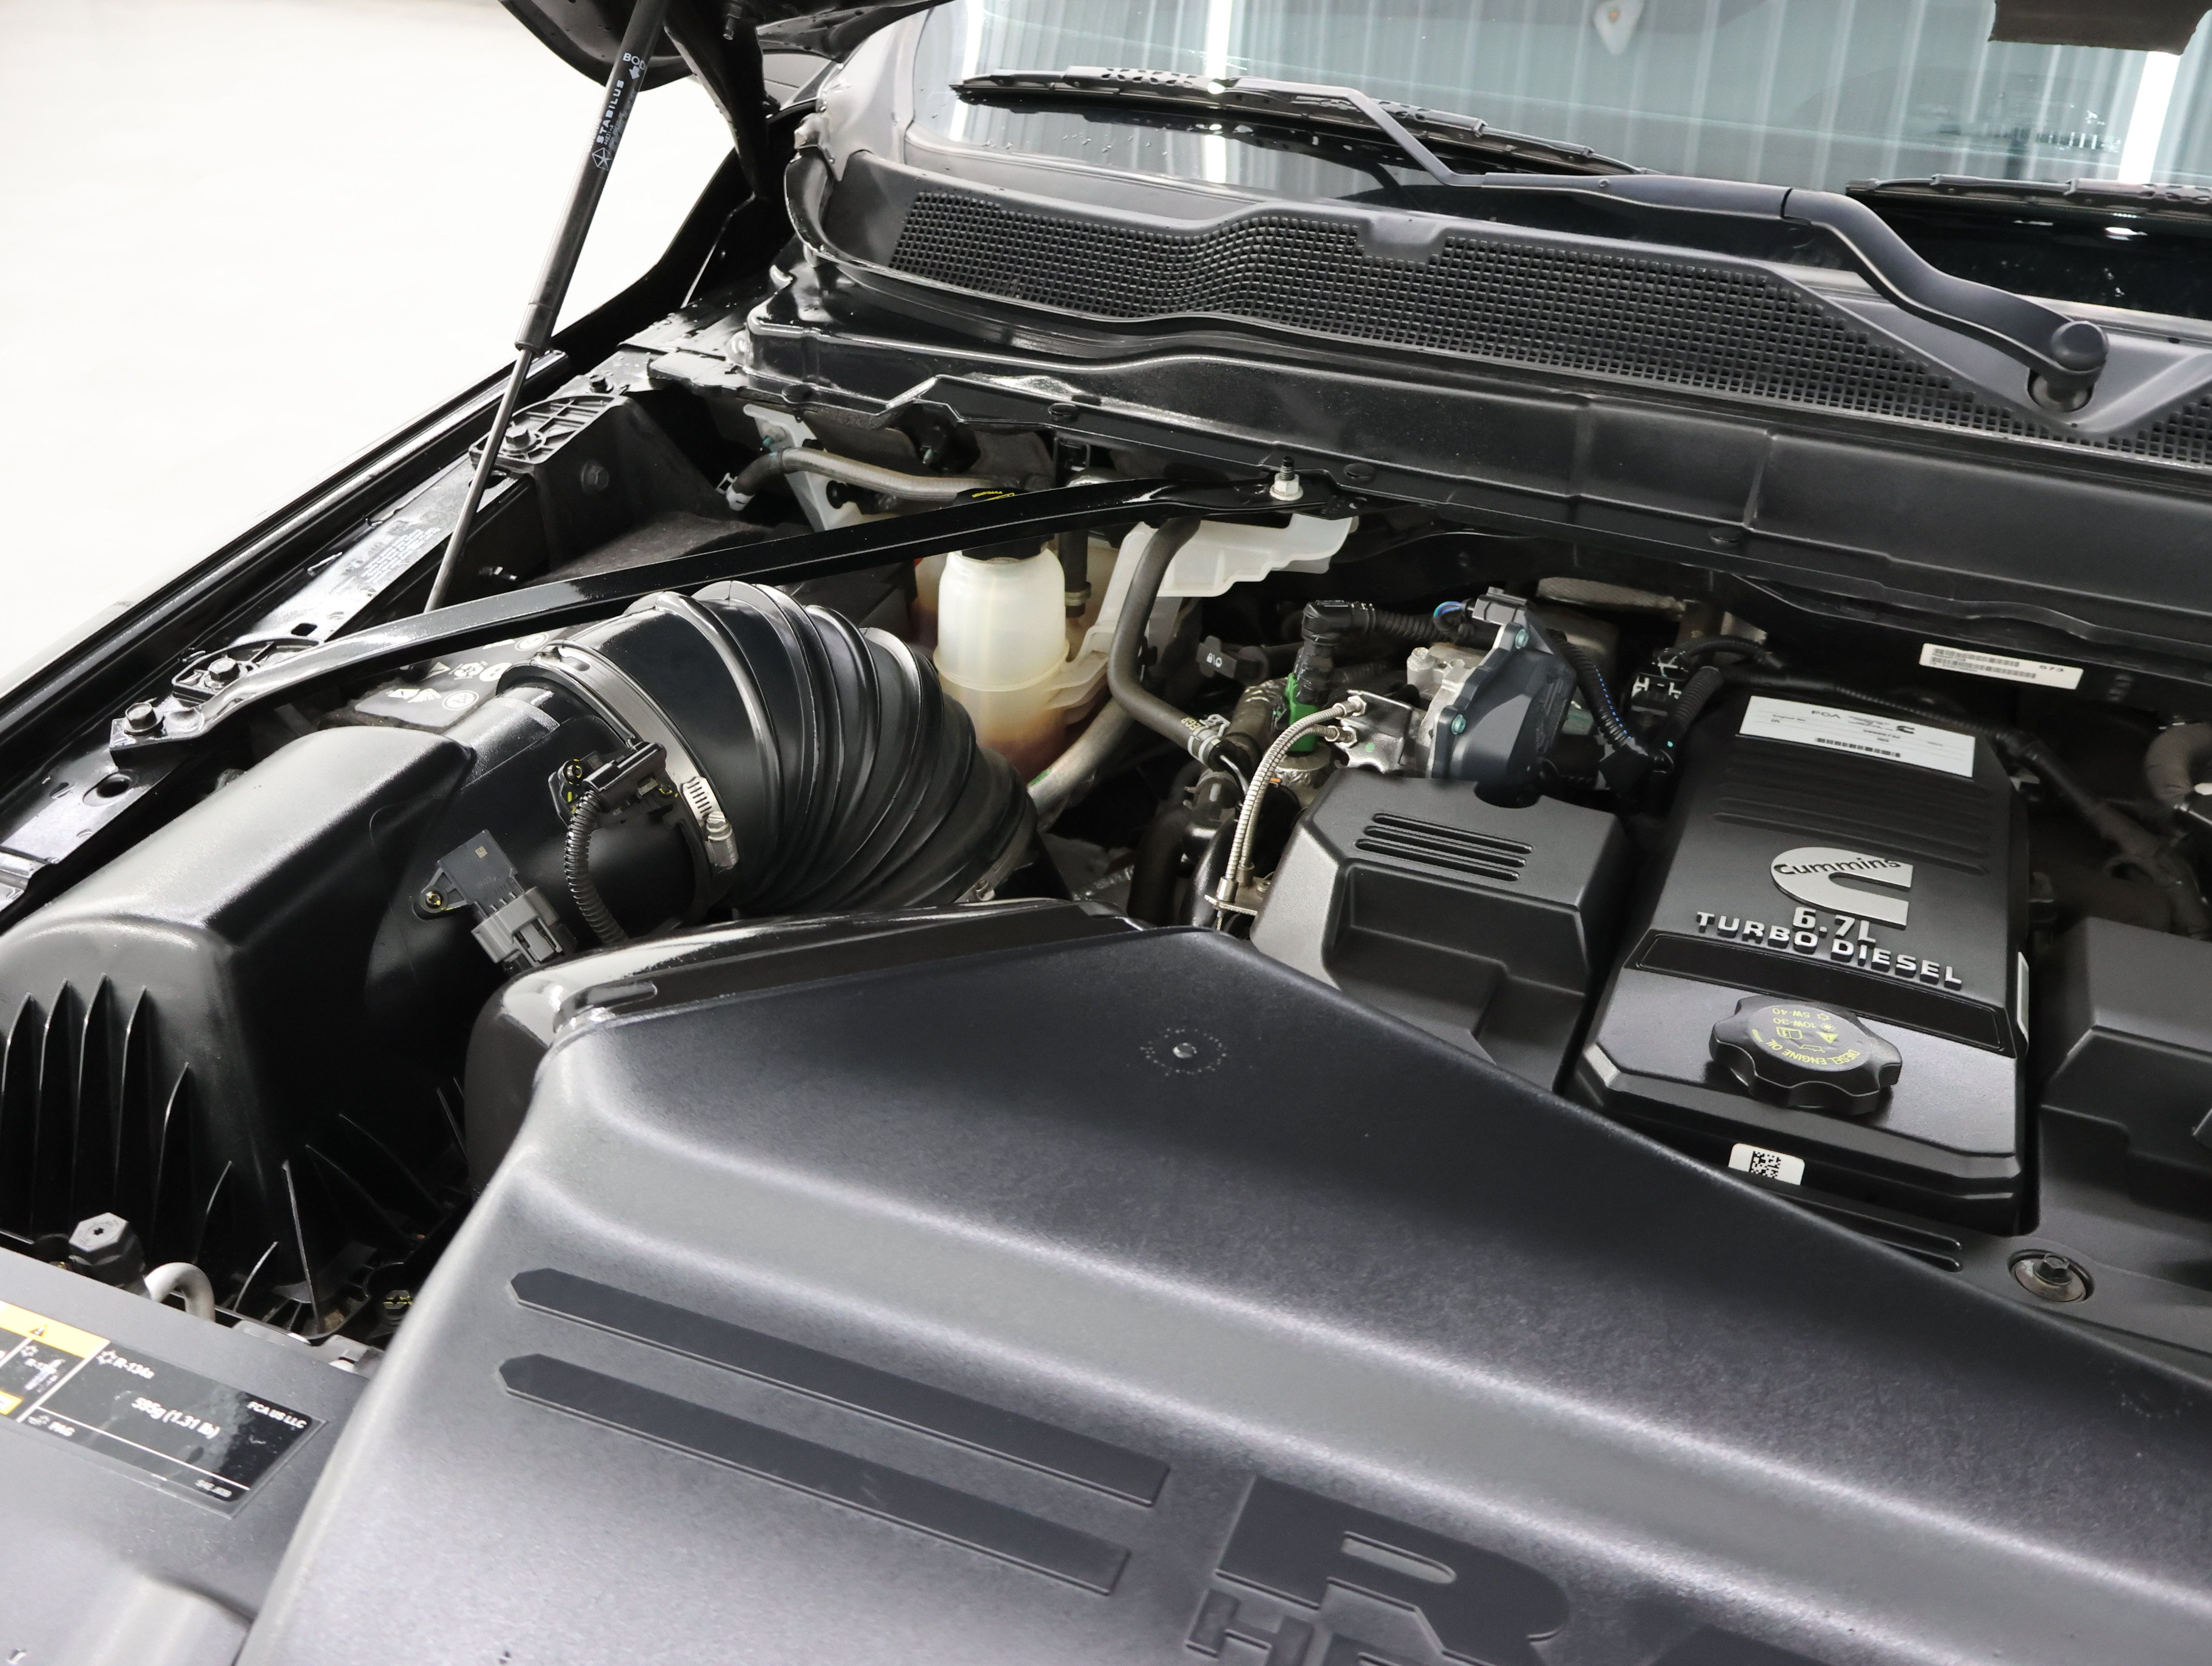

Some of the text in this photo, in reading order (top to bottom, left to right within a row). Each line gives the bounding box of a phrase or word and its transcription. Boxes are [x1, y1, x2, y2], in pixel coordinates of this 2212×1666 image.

[596, 79, 624, 144] STABILUS
[1181, 717, 1202, 731] EGR
[1812, 710, 1841, 718] FCA
[1773, 857, 1902, 875] Cummins
[1792, 906, 1876, 946] 6.7L
[1697, 911, 1962, 989] TURBO DIESEL
[1772, 1008, 1810, 1018] 5W-40
[1773, 1017, 1817, 1029] 10W-30
[1766, 1039, 1861, 1065] DIESEL ENGINE OIL
[246, 1401, 307, 1429] FCA US LLC
